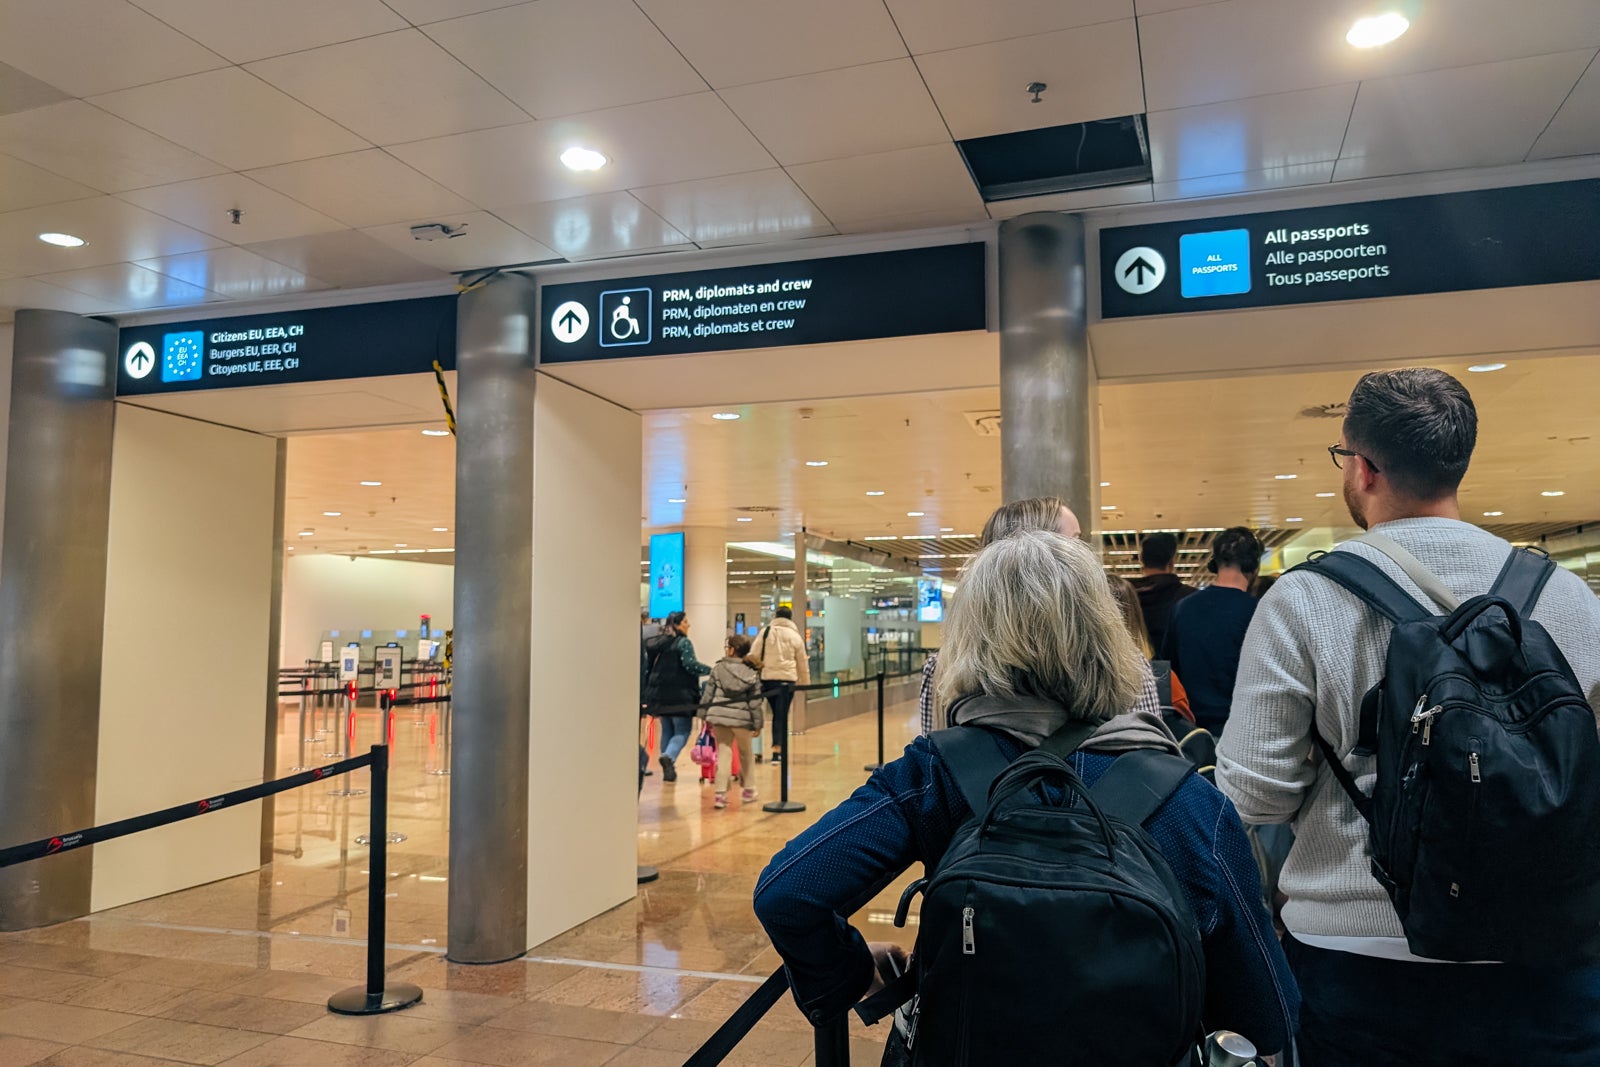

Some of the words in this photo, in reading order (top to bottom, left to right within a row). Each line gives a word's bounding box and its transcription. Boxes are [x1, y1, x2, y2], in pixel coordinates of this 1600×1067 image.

[1264, 228, 1288, 245] All
[1290, 222, 1370, 245] passports
[1206, 254, 1222, 263] ALL
[1265, 250, 1295, 266] Alle
[1297, 244, 1387, 266] paspoorten
[1192, 263, 1238, 274] PASSPORTS
[1265, 272, 1303, 287] Tous
[1305, 264, 1390, 286] passeports
[662, 288, 694, 303] PRM,
[694, 283, 756, 301] diplomats
[757, 278, 780, 294] and
[781, 279, 813, 292] crew
[662, 307, 692, 321] PRM,
[693, 302, 758, 320] diplomaten
[759, 301, 775, 313] en
[776, 298, 807, 311] crew
[210, 331, 247, 344] Citizens
[248, 328, 265, 341] EU,
[265, 326, 288, 339] EEA,
[288, 325, 304, 337] CH
[662, 325, 692, 339] PRM,
[692, 320, 750, 338] diplomats
[751, 319, 765, 332] et
[765, 318, 795, 331] crew
[210, 348, 245, 361] Burgers
[245, 345, 262, 357] EU,
[261, 343, 282, 356] EER,
[282, 342, 297, 354] CH
[208, 362, 247, 376] Citoyens
[248, 360, 263, 373] UE,
[263, 358, 284, 371] EEE,
[284, 357, 299, 369] CH
